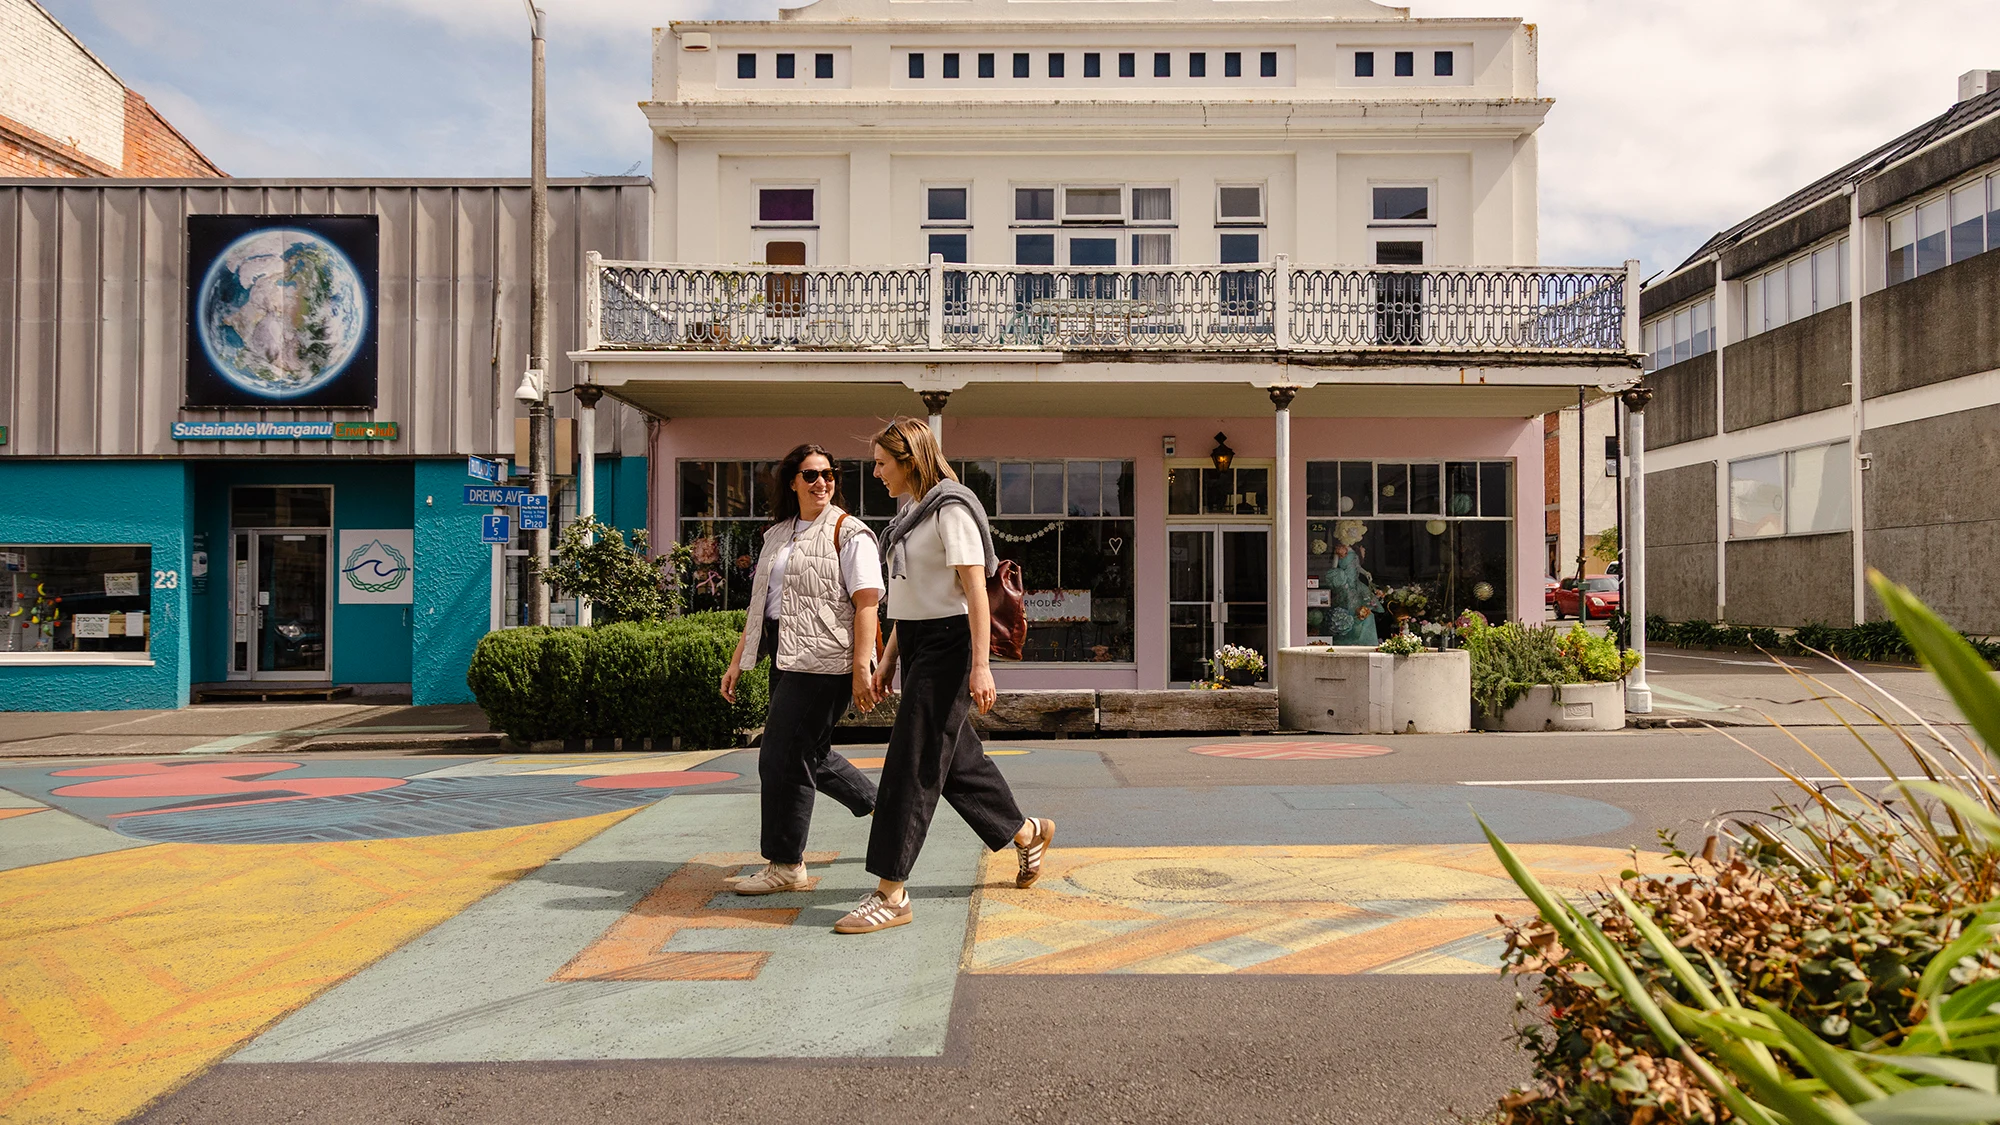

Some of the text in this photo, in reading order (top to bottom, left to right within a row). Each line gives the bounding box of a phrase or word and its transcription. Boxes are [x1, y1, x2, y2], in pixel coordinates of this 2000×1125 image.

[469, 489, 503, 503] DREWS
[527, 496, 534, 505] P
[492, 517, 500, 527] P
[493, 527, 499, 536] 5
[154, 570, 178, 589] 23
[1024, 599, 1062, 607] RHODES
